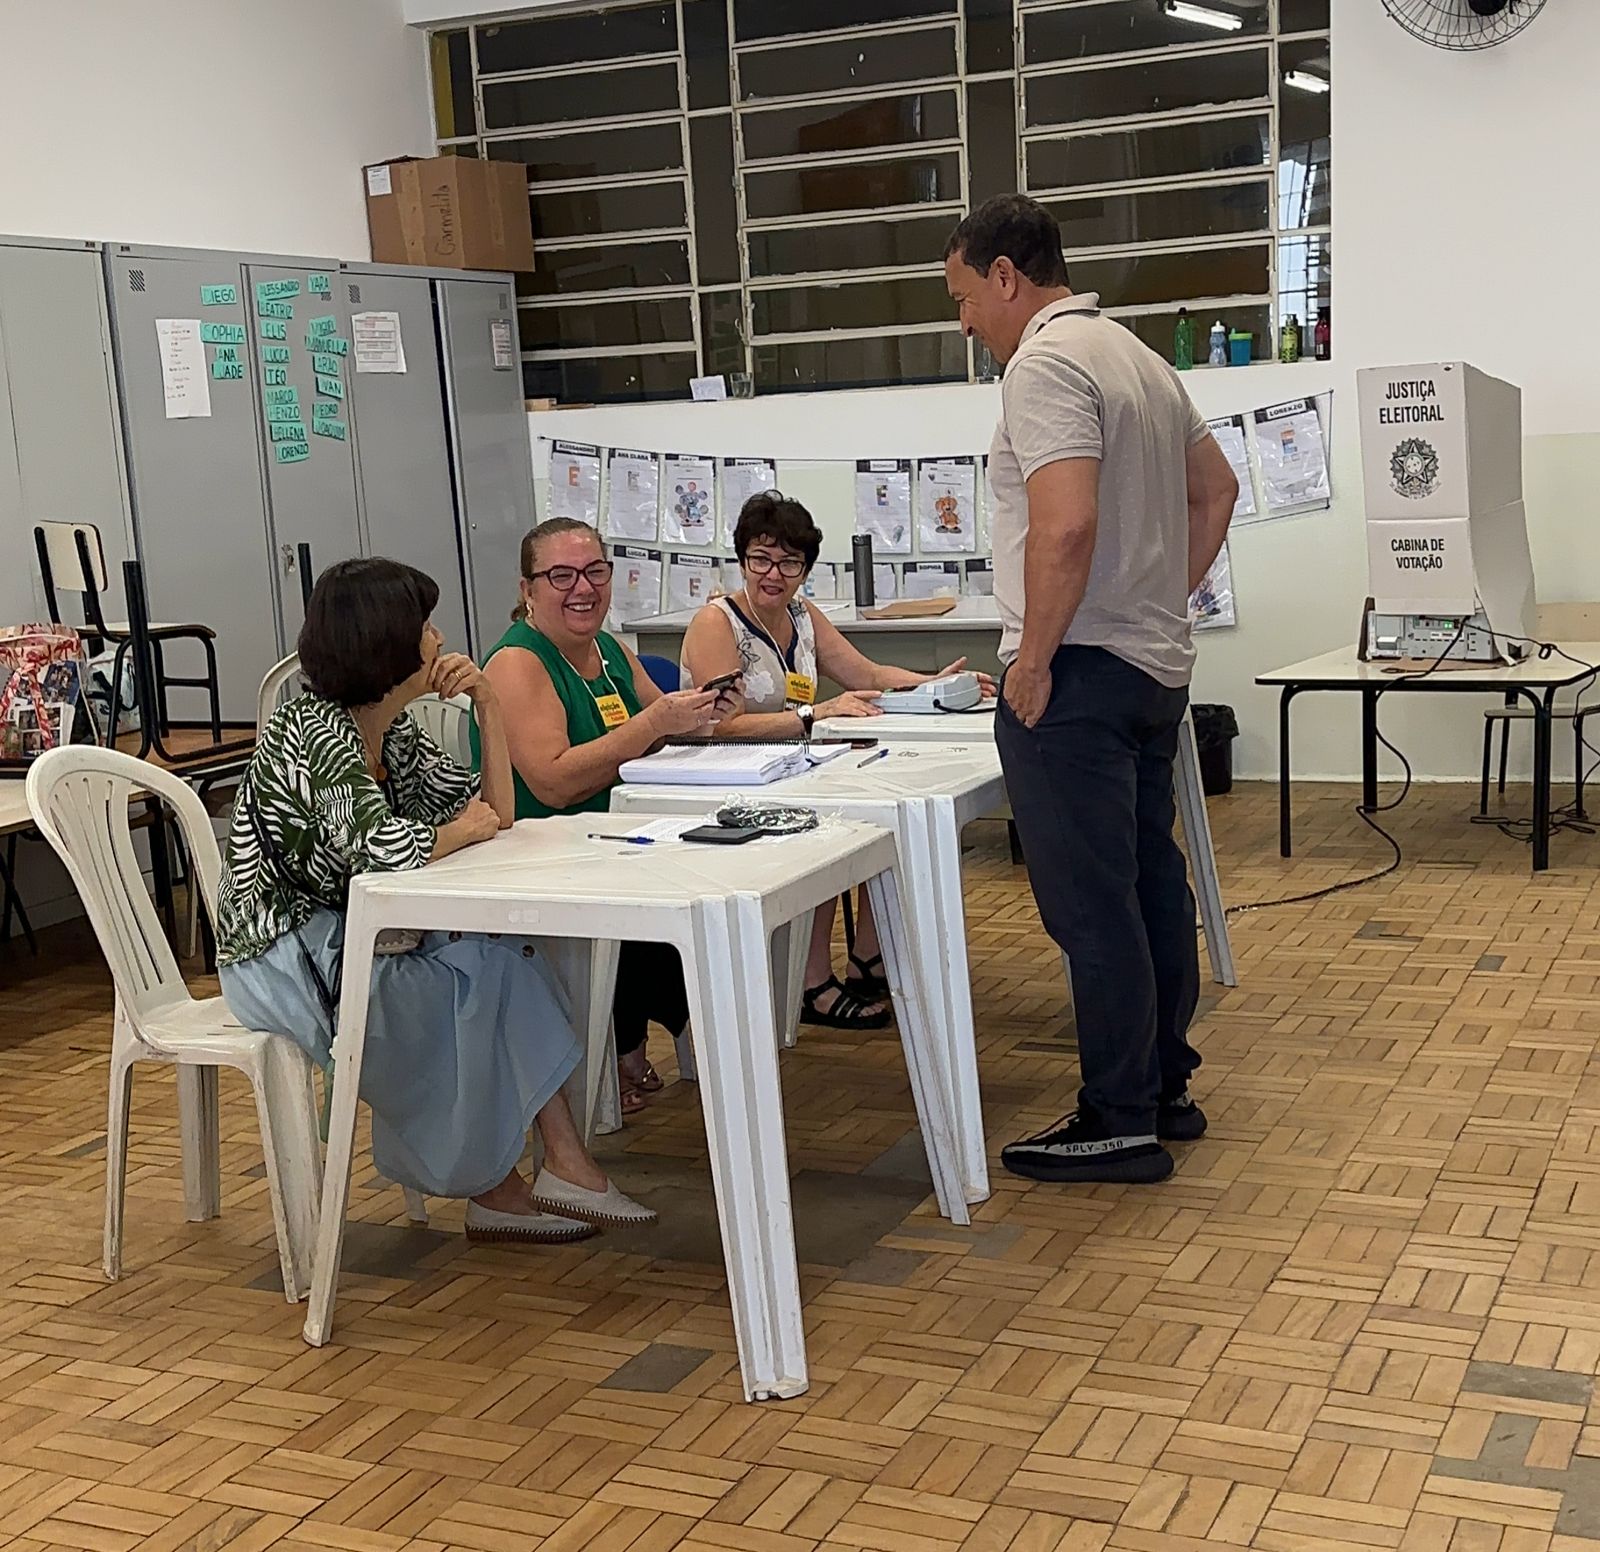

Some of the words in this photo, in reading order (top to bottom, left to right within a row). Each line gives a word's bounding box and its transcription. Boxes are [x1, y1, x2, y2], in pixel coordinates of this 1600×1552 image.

[1385, 380, 1436, 401] JUSTIÇA
[1269, 402, 1304, 417] LORENZO
[1379, 404, 1445, 424] ELEITORAL
[1391, 538, 1429, 551] CABINA
[1430, 538, 1445, 551] DE
[1396, 554, 1443, 572] VOTAÇÃO
